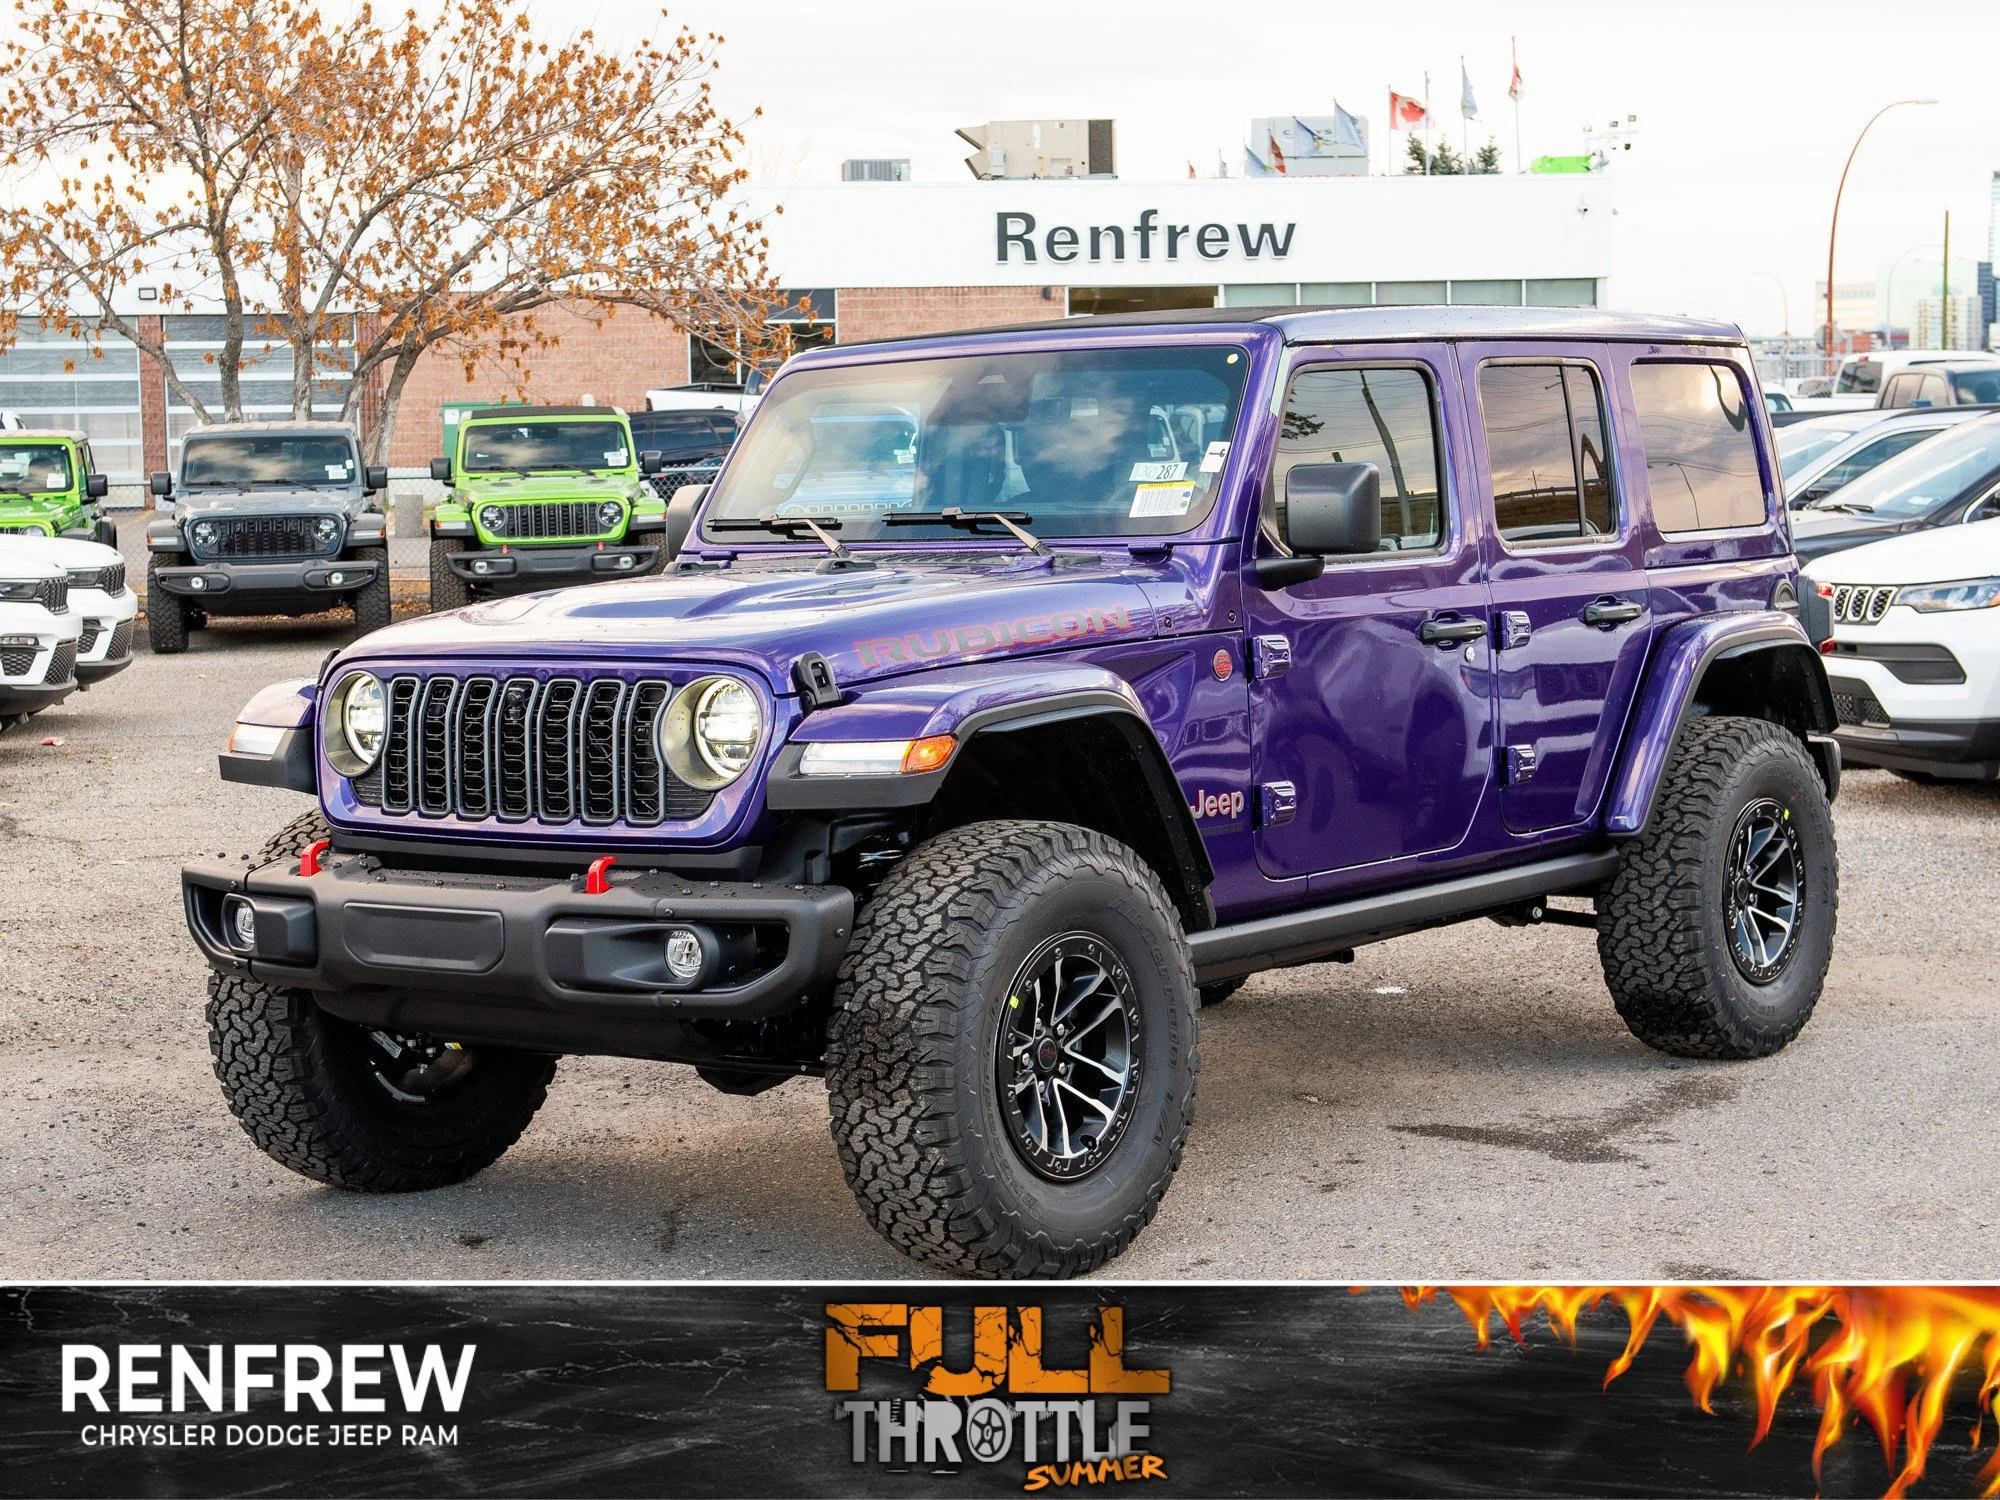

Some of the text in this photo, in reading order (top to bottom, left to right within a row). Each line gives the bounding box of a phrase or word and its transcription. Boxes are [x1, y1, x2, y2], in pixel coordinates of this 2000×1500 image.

[996, 209, 1297, 264] Renfrew
[853, 604, 1132, 669] RUBICON
[1189, 788, 1245, 820] Jeep
